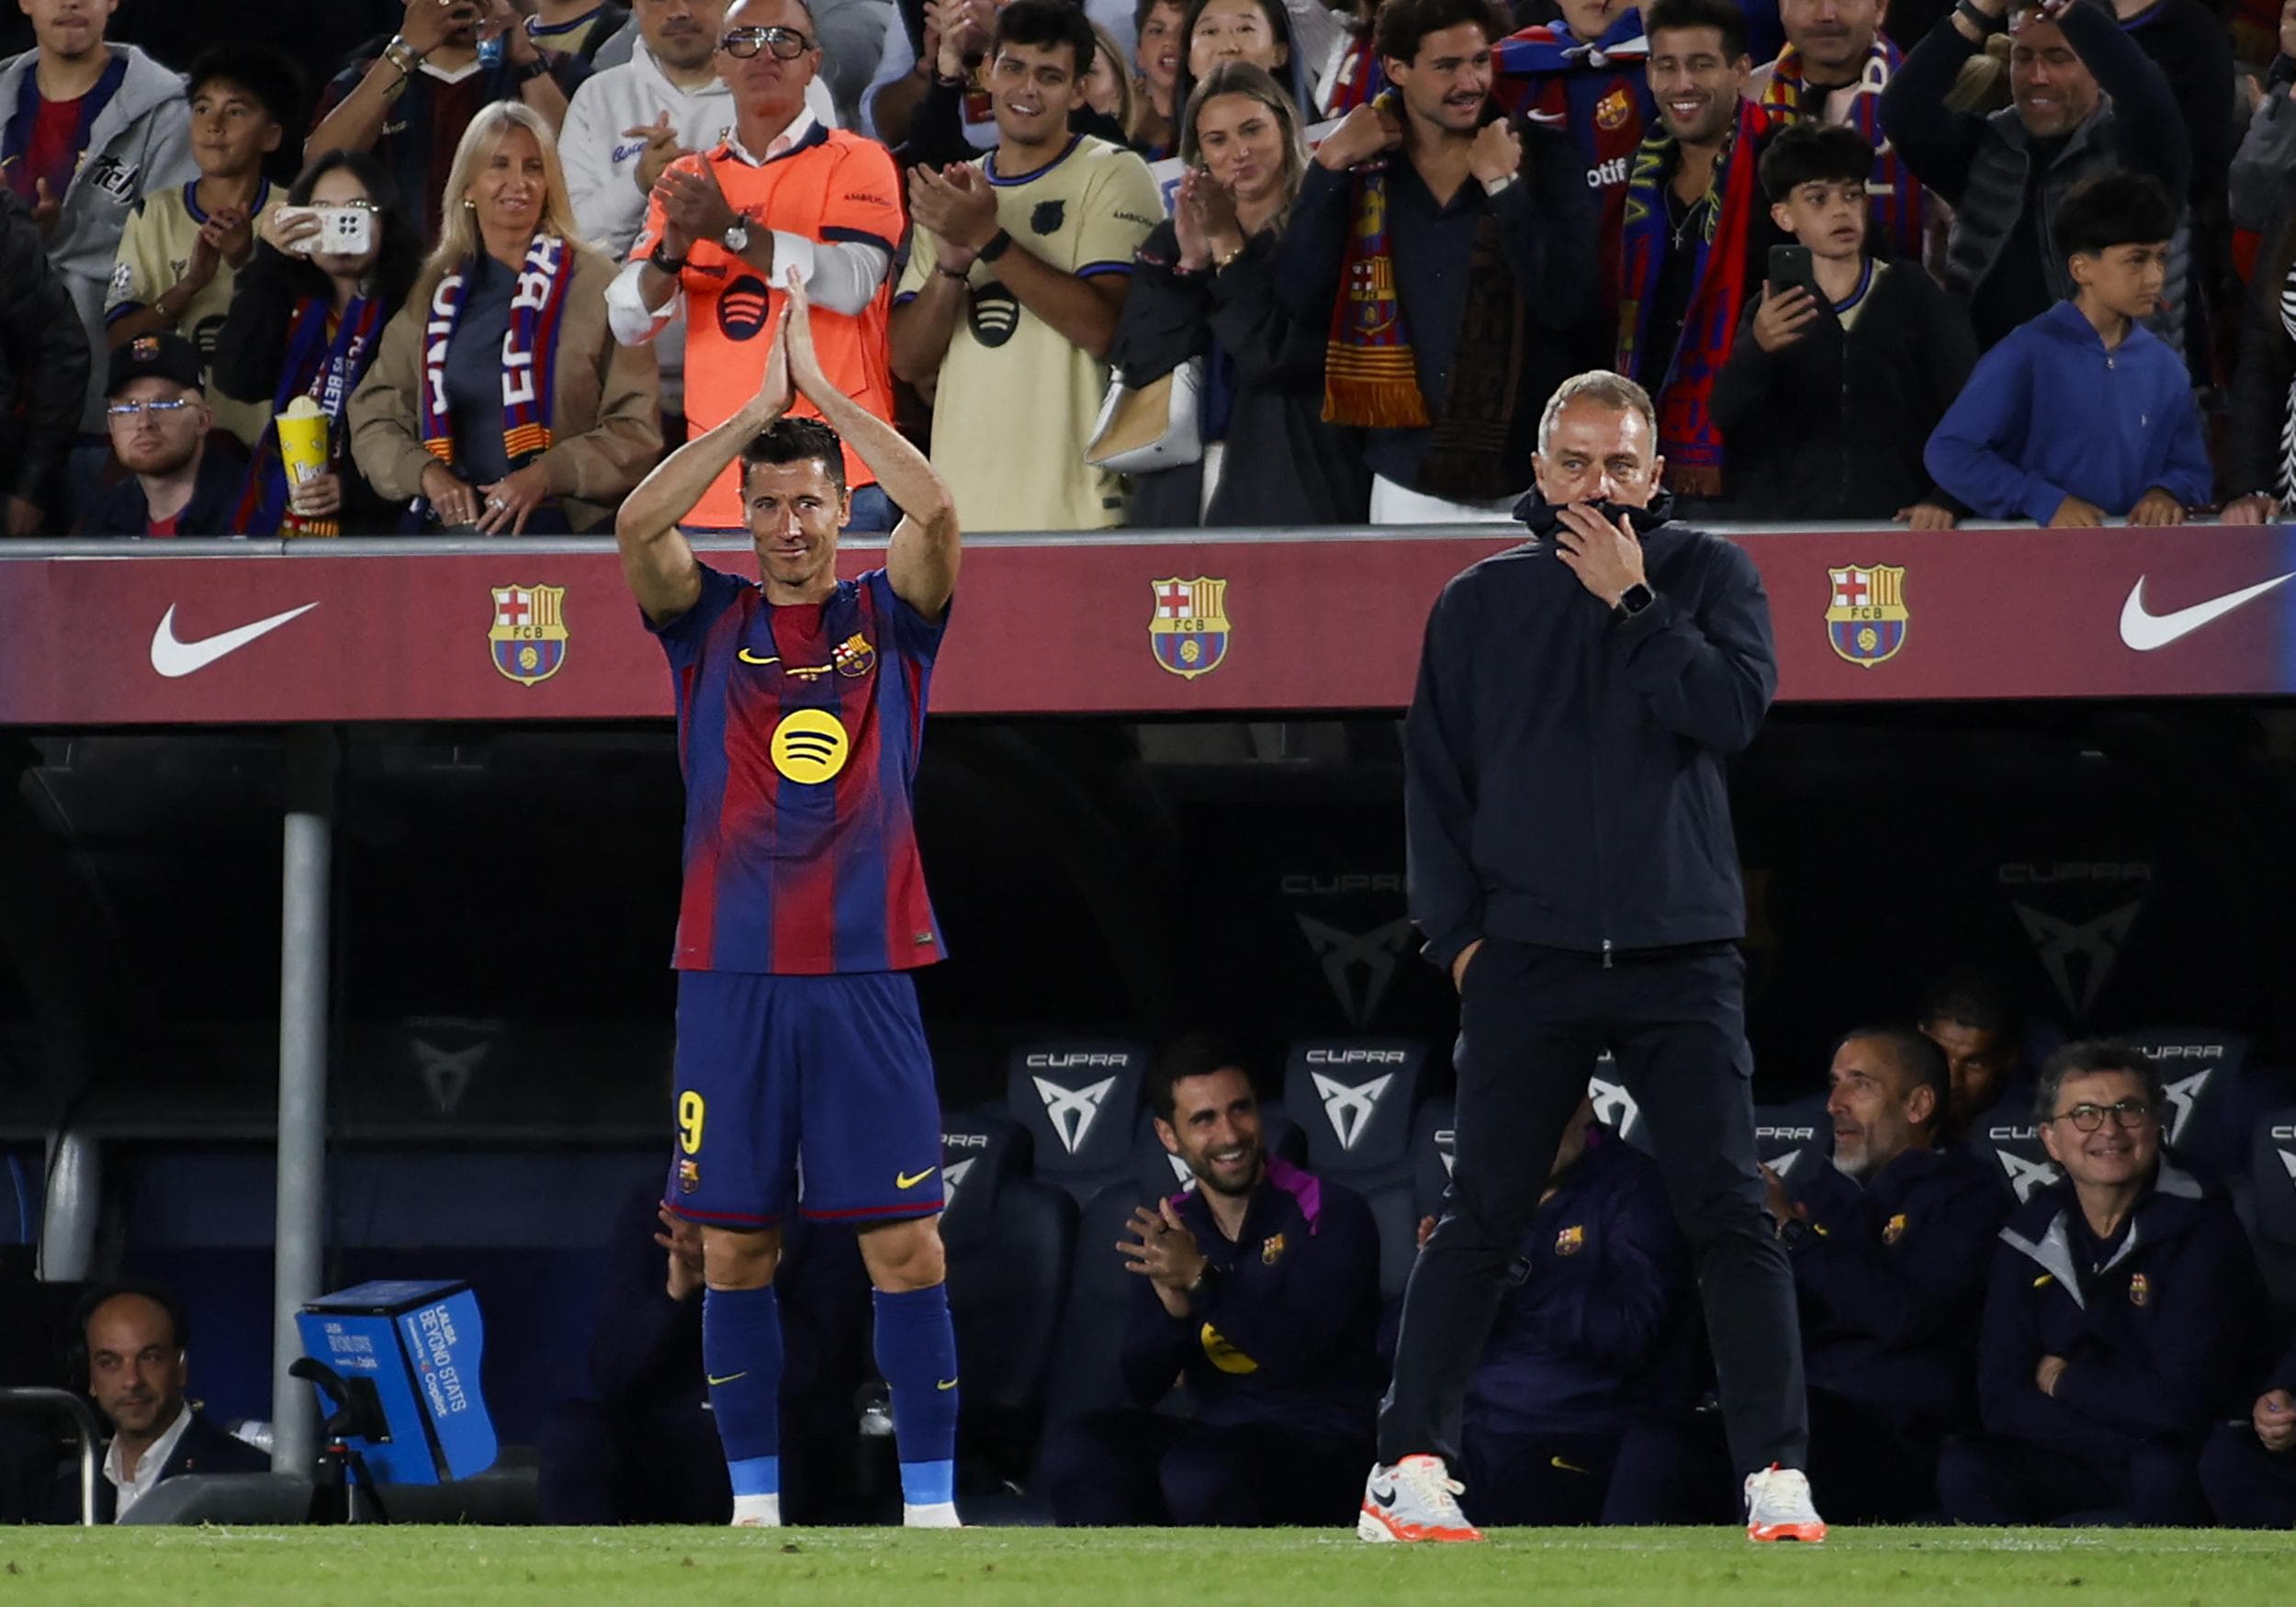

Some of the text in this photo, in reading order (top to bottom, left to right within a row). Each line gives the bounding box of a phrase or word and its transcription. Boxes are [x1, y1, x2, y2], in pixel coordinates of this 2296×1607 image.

[1851, 607, 1882, 620] FCB
[512, 626, 544, 639] FCB
[1174, 619, 1204, 632] FCB
[1306, 1050, 1405, 1063] CUPRA
[2137, 1045, 2223, 1060] UPRA
[1026, 1053, 1128, 1067] CUPRA
[679, 1090, 704, 1155] 9
[419, 1309, 467, 1412] BEYOND STATS
[425, 1372, 447, 1419] Copilot
